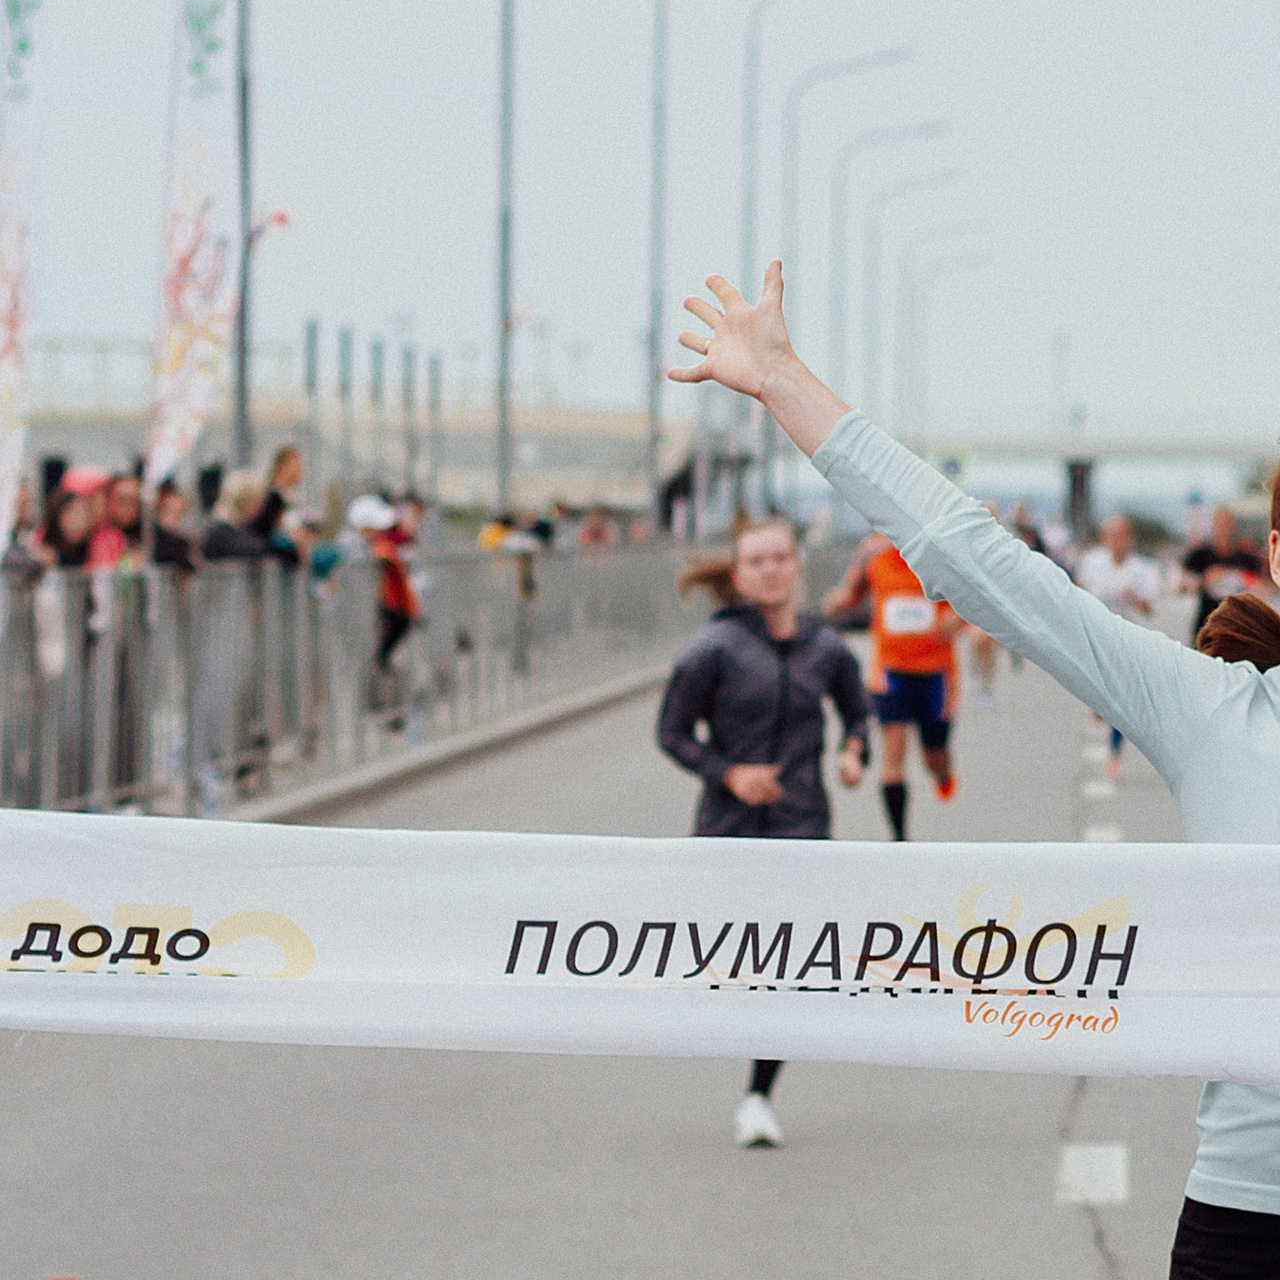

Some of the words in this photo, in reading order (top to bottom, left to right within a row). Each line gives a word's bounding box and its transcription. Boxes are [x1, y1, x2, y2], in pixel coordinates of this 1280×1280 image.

[10, 922, 211, 966] додо
[504, 918, 1139, 987] ПОЛУМАРАФОН
[965, 1000, 1119, 1041] Volgograd
